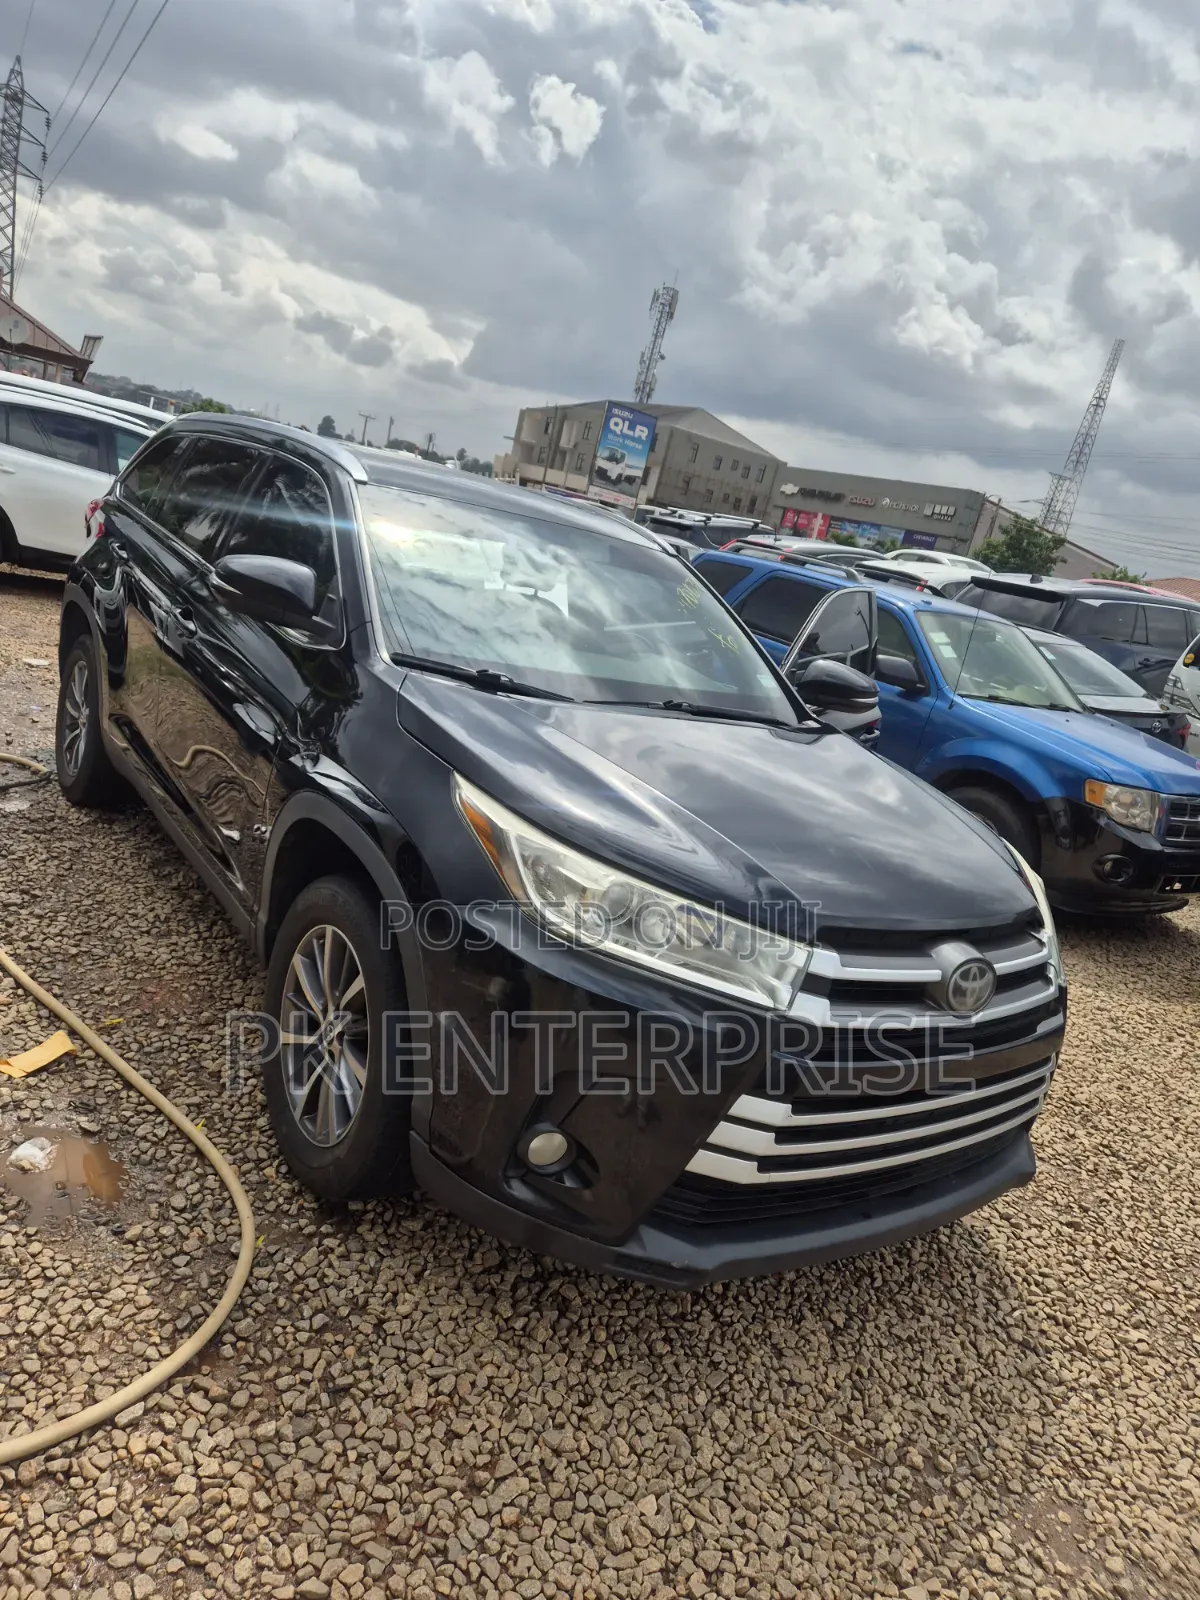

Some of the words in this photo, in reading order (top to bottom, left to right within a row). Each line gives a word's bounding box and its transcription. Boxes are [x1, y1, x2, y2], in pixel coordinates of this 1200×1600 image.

[612, 408, 634, 419] ISUZU
[609, 417, 649, 441] QLR
[607, 434, 624, 443] Work
[624, 439, 643, 450] Horse
[849, 495, 876, 507] ISUZU
[913, 533, 935, 542] CHEVROLET
